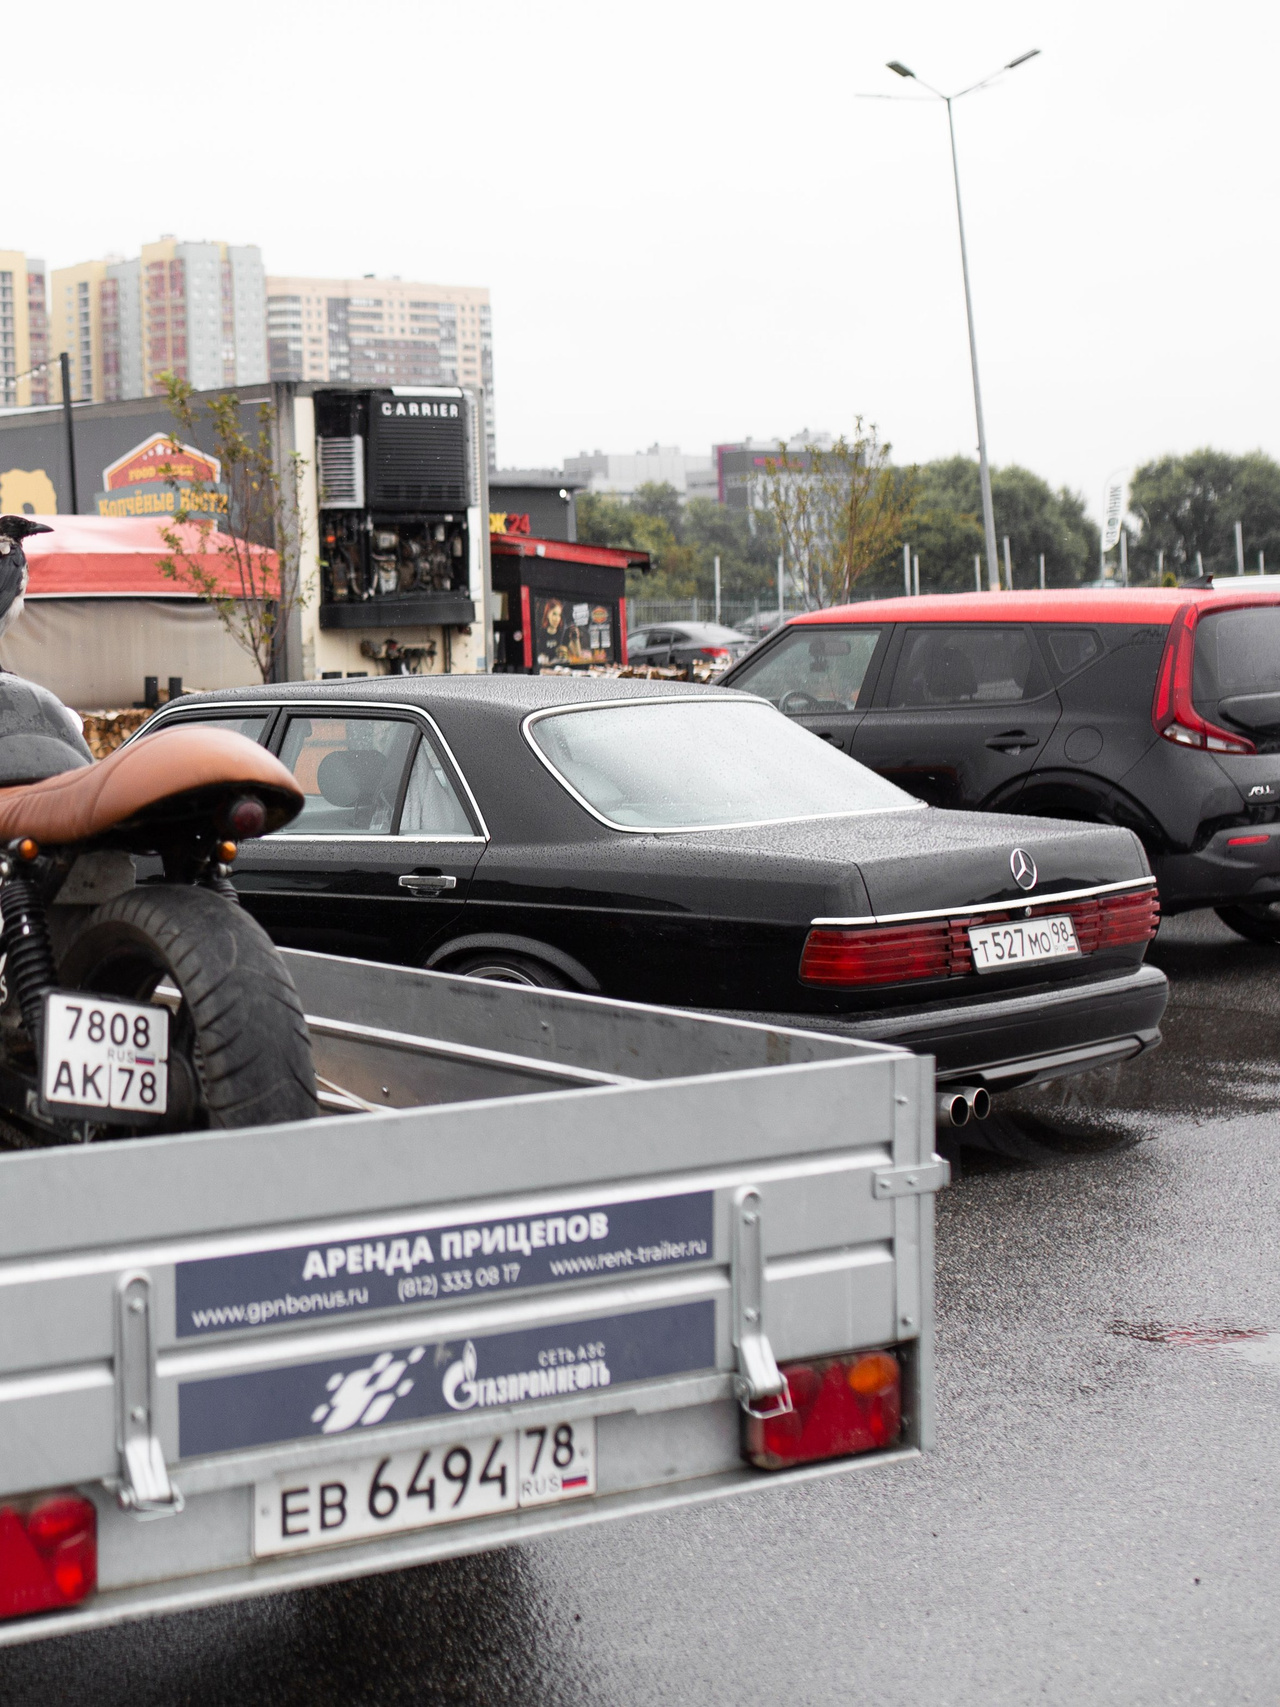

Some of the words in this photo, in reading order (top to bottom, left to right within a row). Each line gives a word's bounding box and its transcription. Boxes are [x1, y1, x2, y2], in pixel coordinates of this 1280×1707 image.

[381, 401, 459, 418] CARRIER
[508, 512, 531, 535] 24
[1051, 920, 1070, 944] 98
[65, 1004, 151, 1049] 7808
[52, 1060, 103, 1100] АК
[117, 1066, 157, 1105] 78
[302, 1235, 435, 1282] АРЕНДА
[440, 1211, 609, 1262] ПРИЦЕПОВ
[191, 1286, 370, 1329] www.gpnbonus.ru
[397, 1273, 439, 1303] (812)
[440, 1267, 473, 1294] 333
[475, 1263, 501, 1288] 08
[501, 1261, 521, 1284] 17
[549, 1239, 708, 1277] www.rent-trailer.ru
[537, 1345, 576, 1368] СЕТЬ
[577, 1340, 607, 1362] АЗС
[367, 1436, 508, 1521] 6494
[525, 1422, 576, 1475] 78
[520, 1479, 561, 1500] RUS
